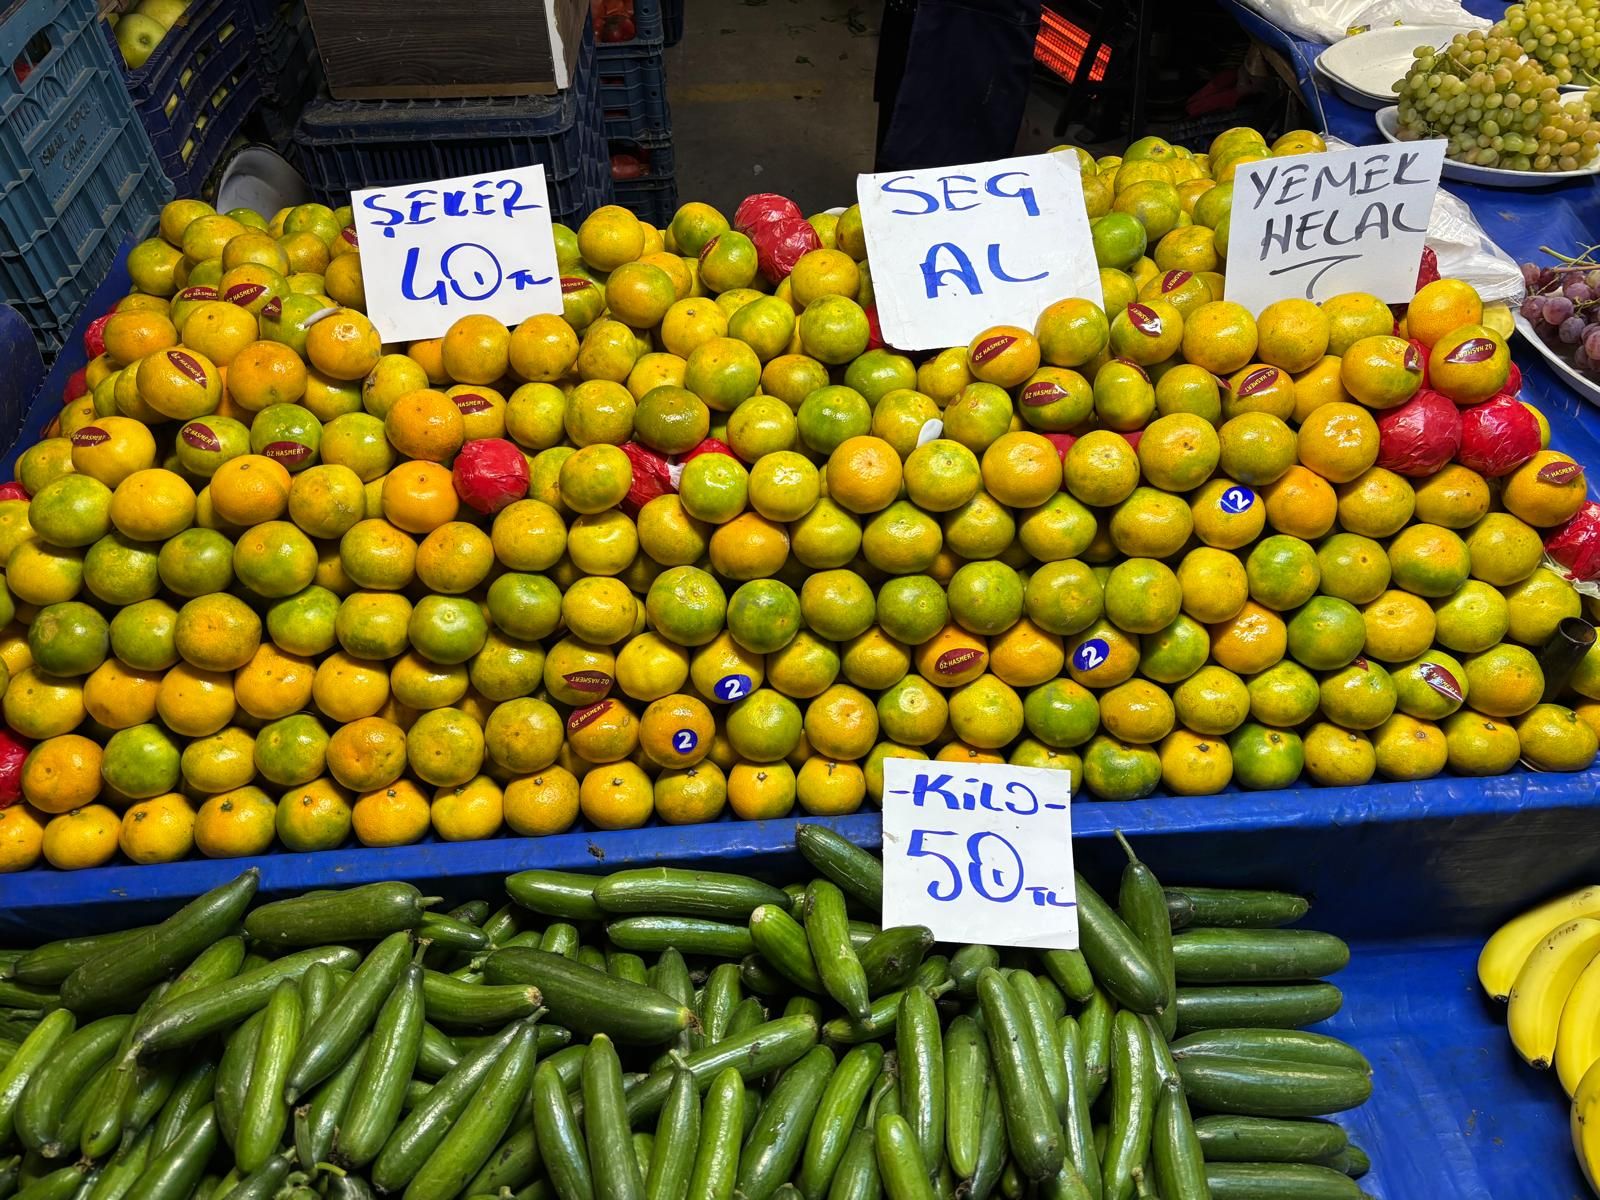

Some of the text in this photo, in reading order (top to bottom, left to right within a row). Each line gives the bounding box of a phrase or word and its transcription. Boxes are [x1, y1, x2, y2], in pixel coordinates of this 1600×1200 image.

[1249, 152, 1431, 210] YEMEK
[363, 179, 543, 238] ŞEKER
[1260, 202, 1428, 261] HELAL
[401, 243, 502, 305] 40
[919, 242, 1049, 299] AL
[232, 287, 258, 300] HASMERT
[983, 337, 1009, 355] HASMERT
[1244, 375, 1268, 392] HASMERT
[190, 430, 217, 446] HASMERT
[275, 448, 304, 457] HASMERT
[1229, 490, 1250, 509] 2
[948, 651, 975, 667] HASMERT
[1082, 646, 1104, 668] 2
[570, 676, 600, 684] HASMERT
[725, 679, 743, 699] 2
[579, 704, 604, 722] HASMERT
[678, 732, 692, 749] 2
[907, 829, 1024, 903] 50
